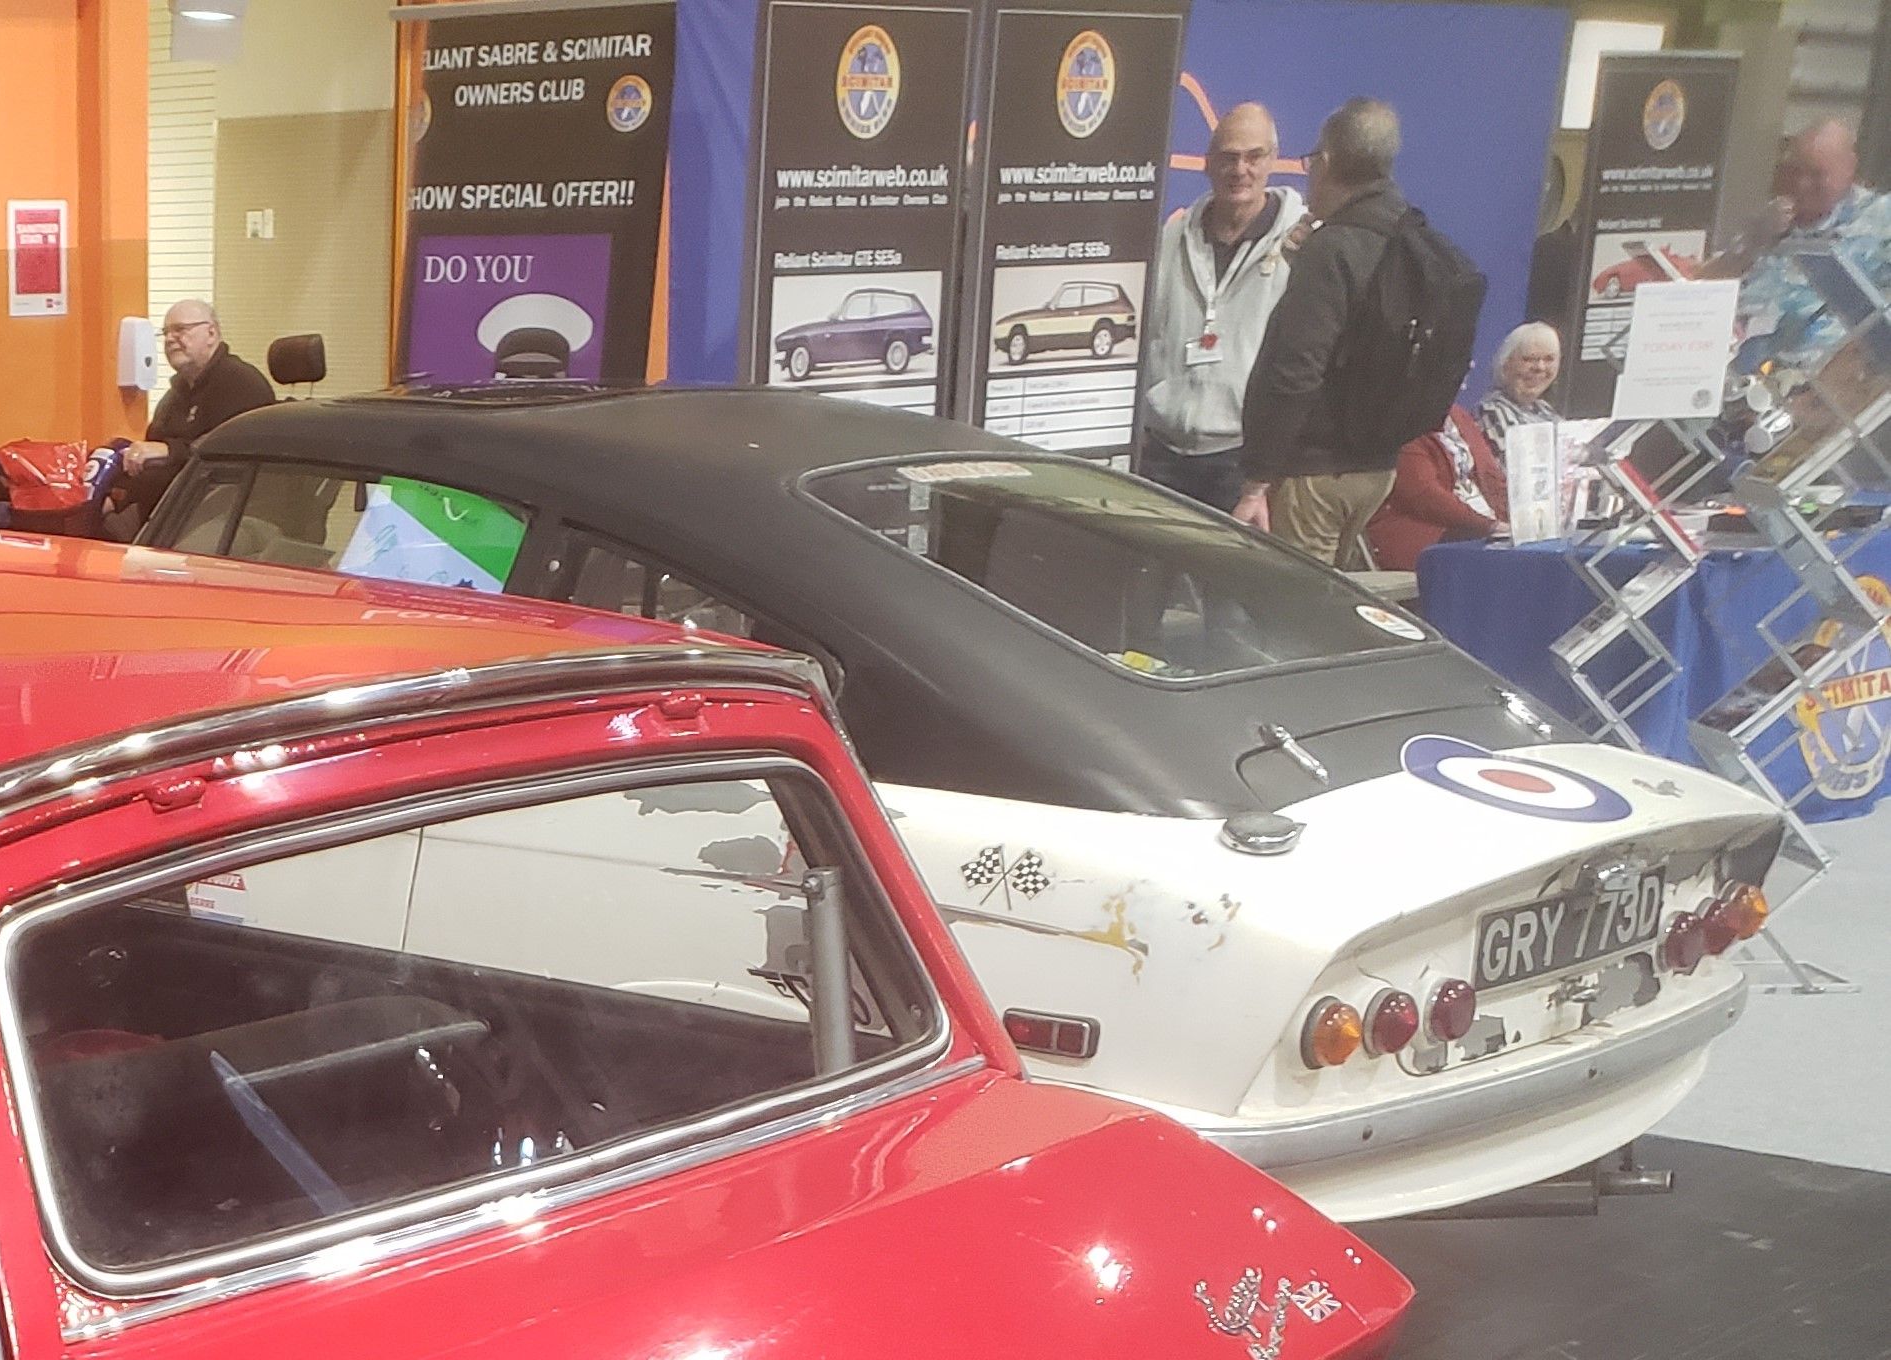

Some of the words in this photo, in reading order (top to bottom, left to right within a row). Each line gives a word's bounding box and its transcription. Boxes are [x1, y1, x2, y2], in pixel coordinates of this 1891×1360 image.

[477, 41, 539, 67] SABRE
[542, 40, 558, 63] &
[561, 33, 653, 60] SCIMITAR
[454, 82, 536, 107] OWNERS
[538, 77, 585, 101] CLUB
[776, 164, 950, 188] www.scimitarweb.co.uk
[409, 186, 457, 211] HOW
[460, 180, 548, 210] SPECIAL
[552, 179, 636, 208] OFFER!!
[423, 255, 468, 283] DO
[473, 254, 535, 283] YOU
[1805, 671, 1891, 710] SIMITA
[1481, 901, 1566, 982] GRY
